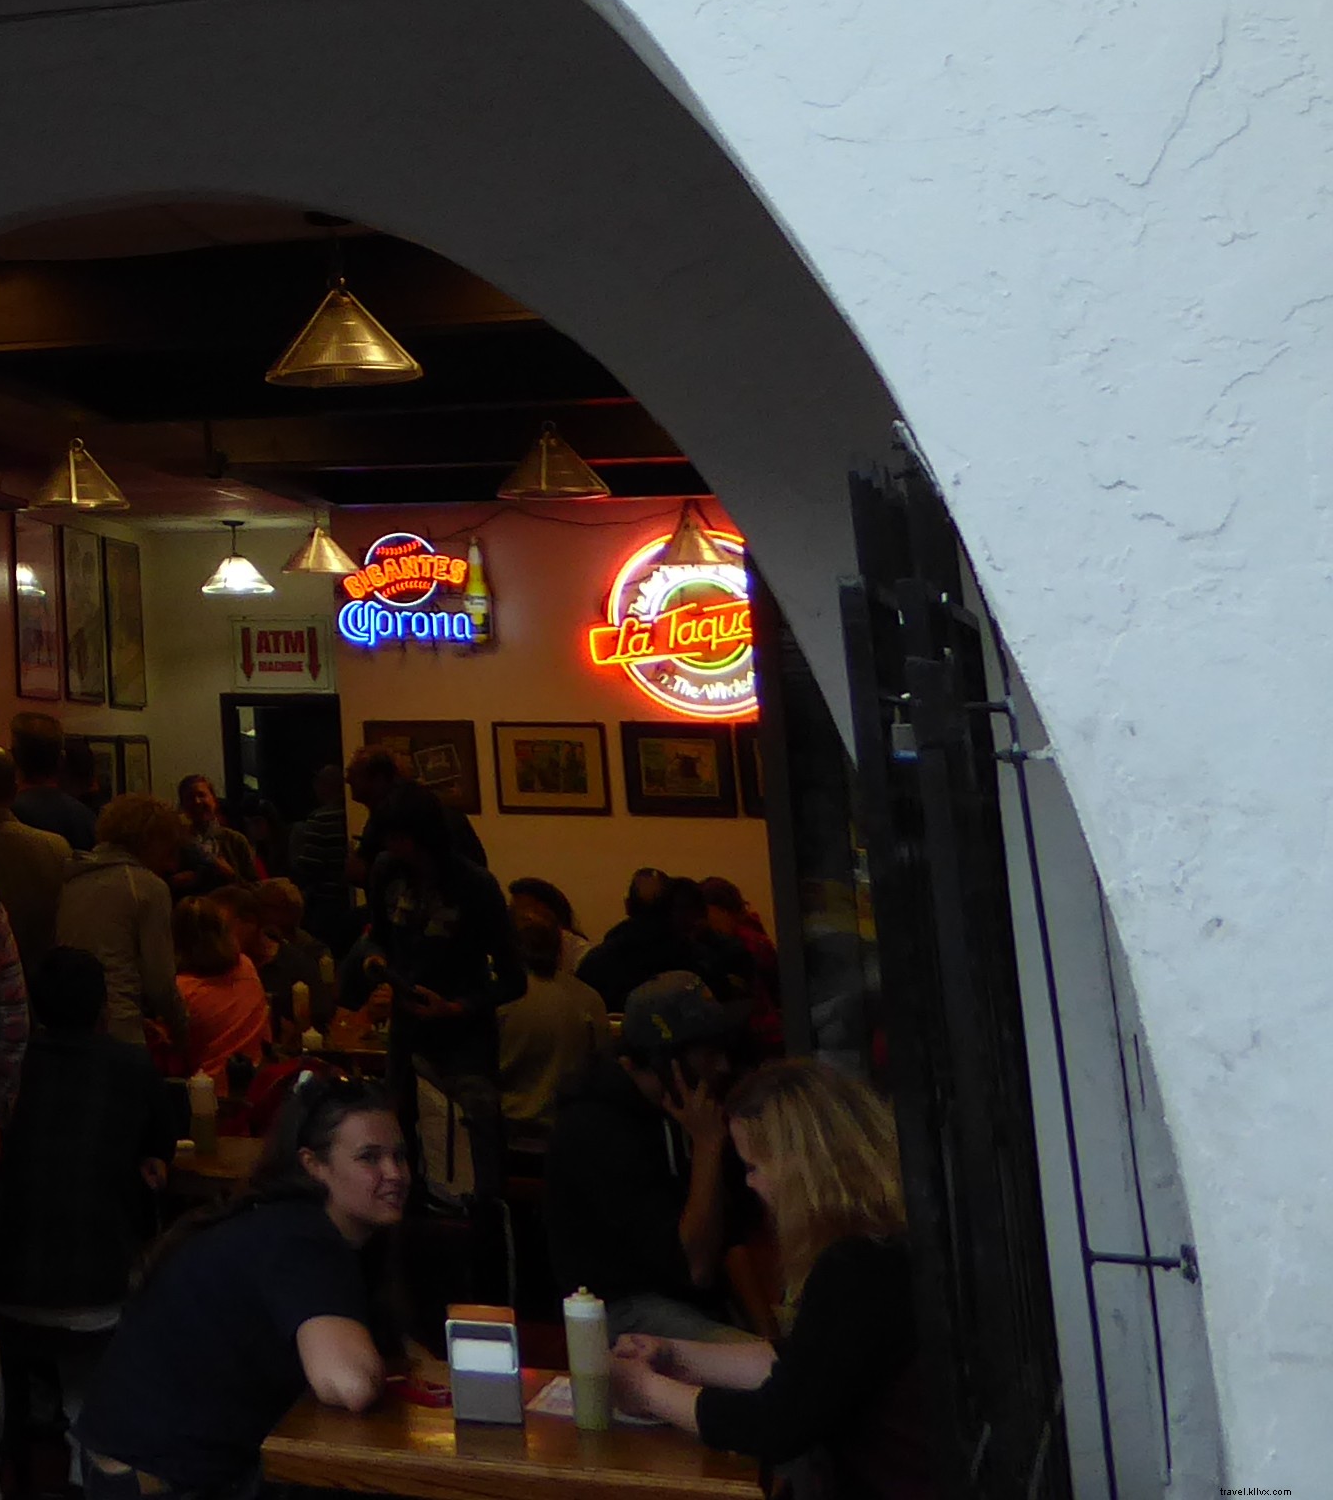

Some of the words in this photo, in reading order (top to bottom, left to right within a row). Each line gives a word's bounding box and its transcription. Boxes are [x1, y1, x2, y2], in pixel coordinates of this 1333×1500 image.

[256, 630, 306, 654] ATM
[338, 600, 472, 646] Corona
[606, 617, 655, 662] La
